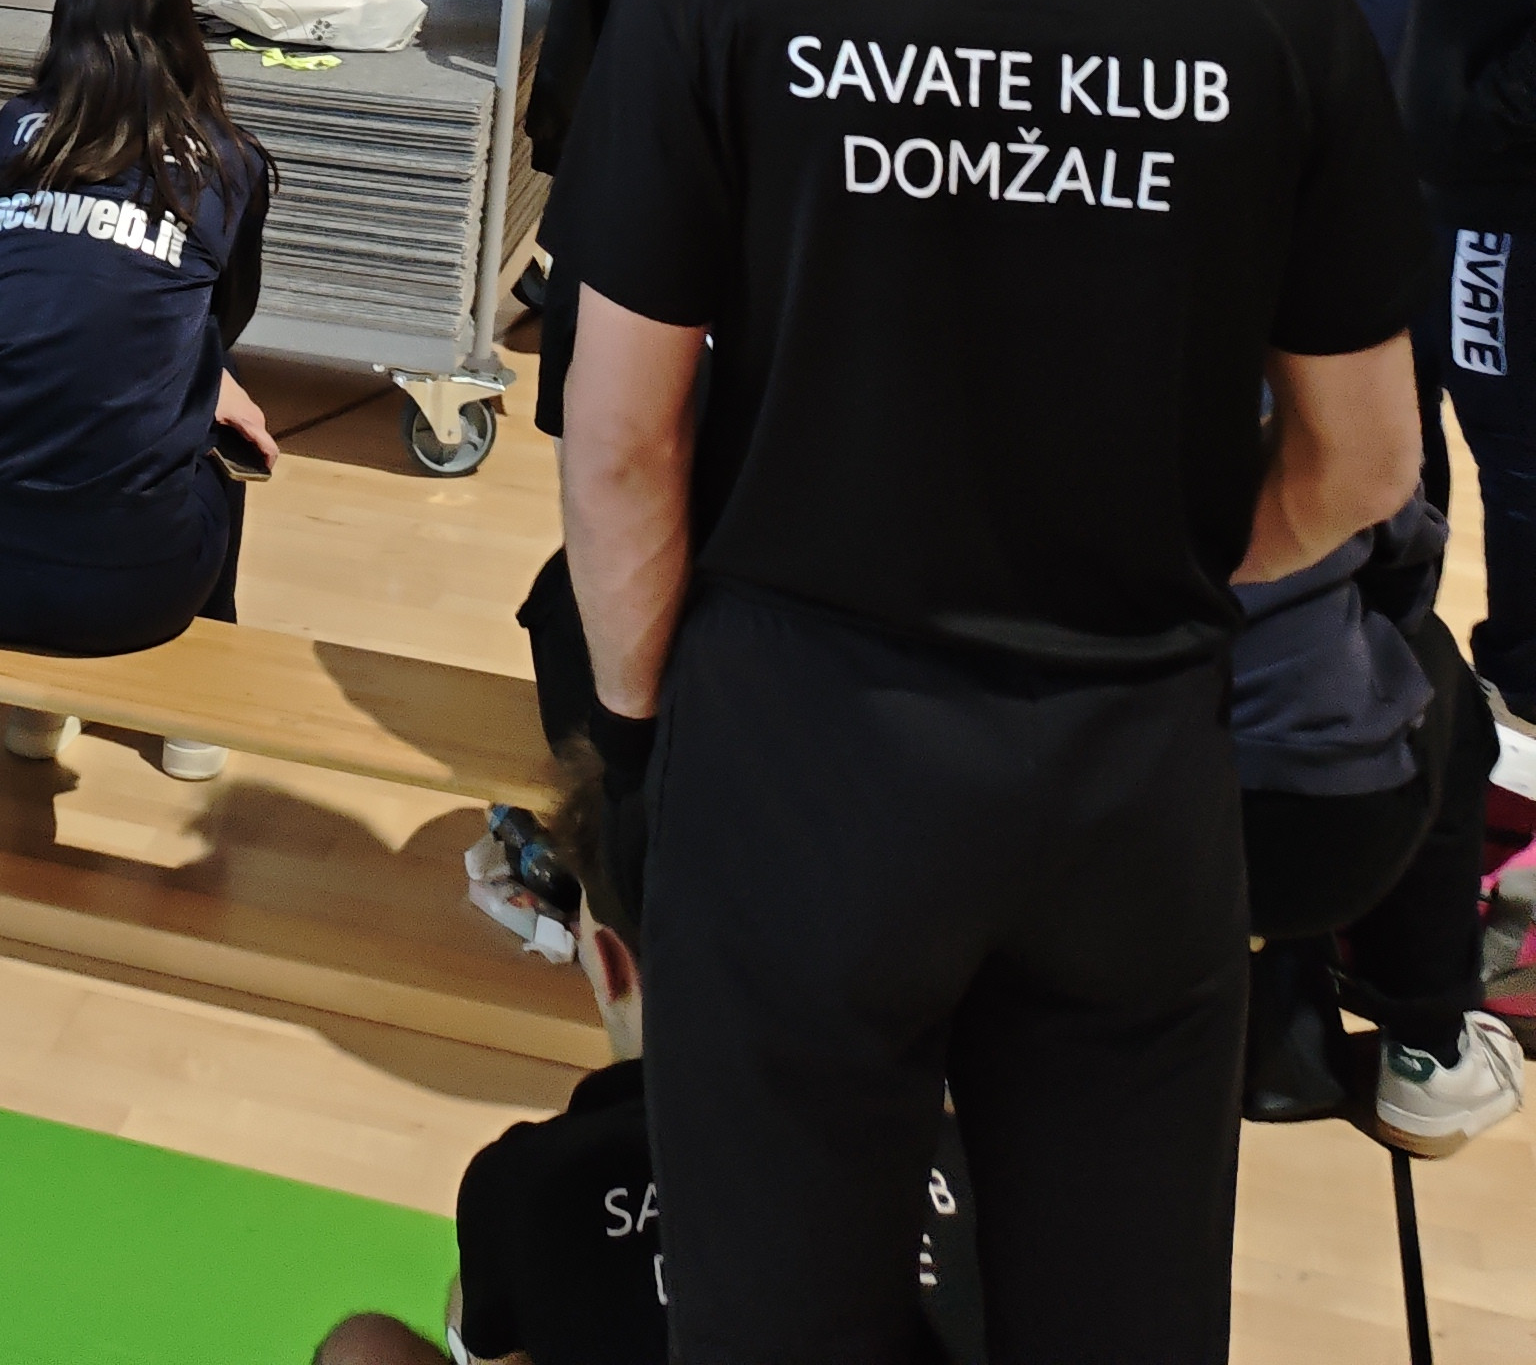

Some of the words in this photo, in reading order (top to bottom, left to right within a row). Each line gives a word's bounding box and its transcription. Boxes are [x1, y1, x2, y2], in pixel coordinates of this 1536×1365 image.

[786, 35, 1033, 112] SAVATE
[1060, 53, 1230, 122] KLUB
[843, 126, 1175, 212] DOMŽALE
